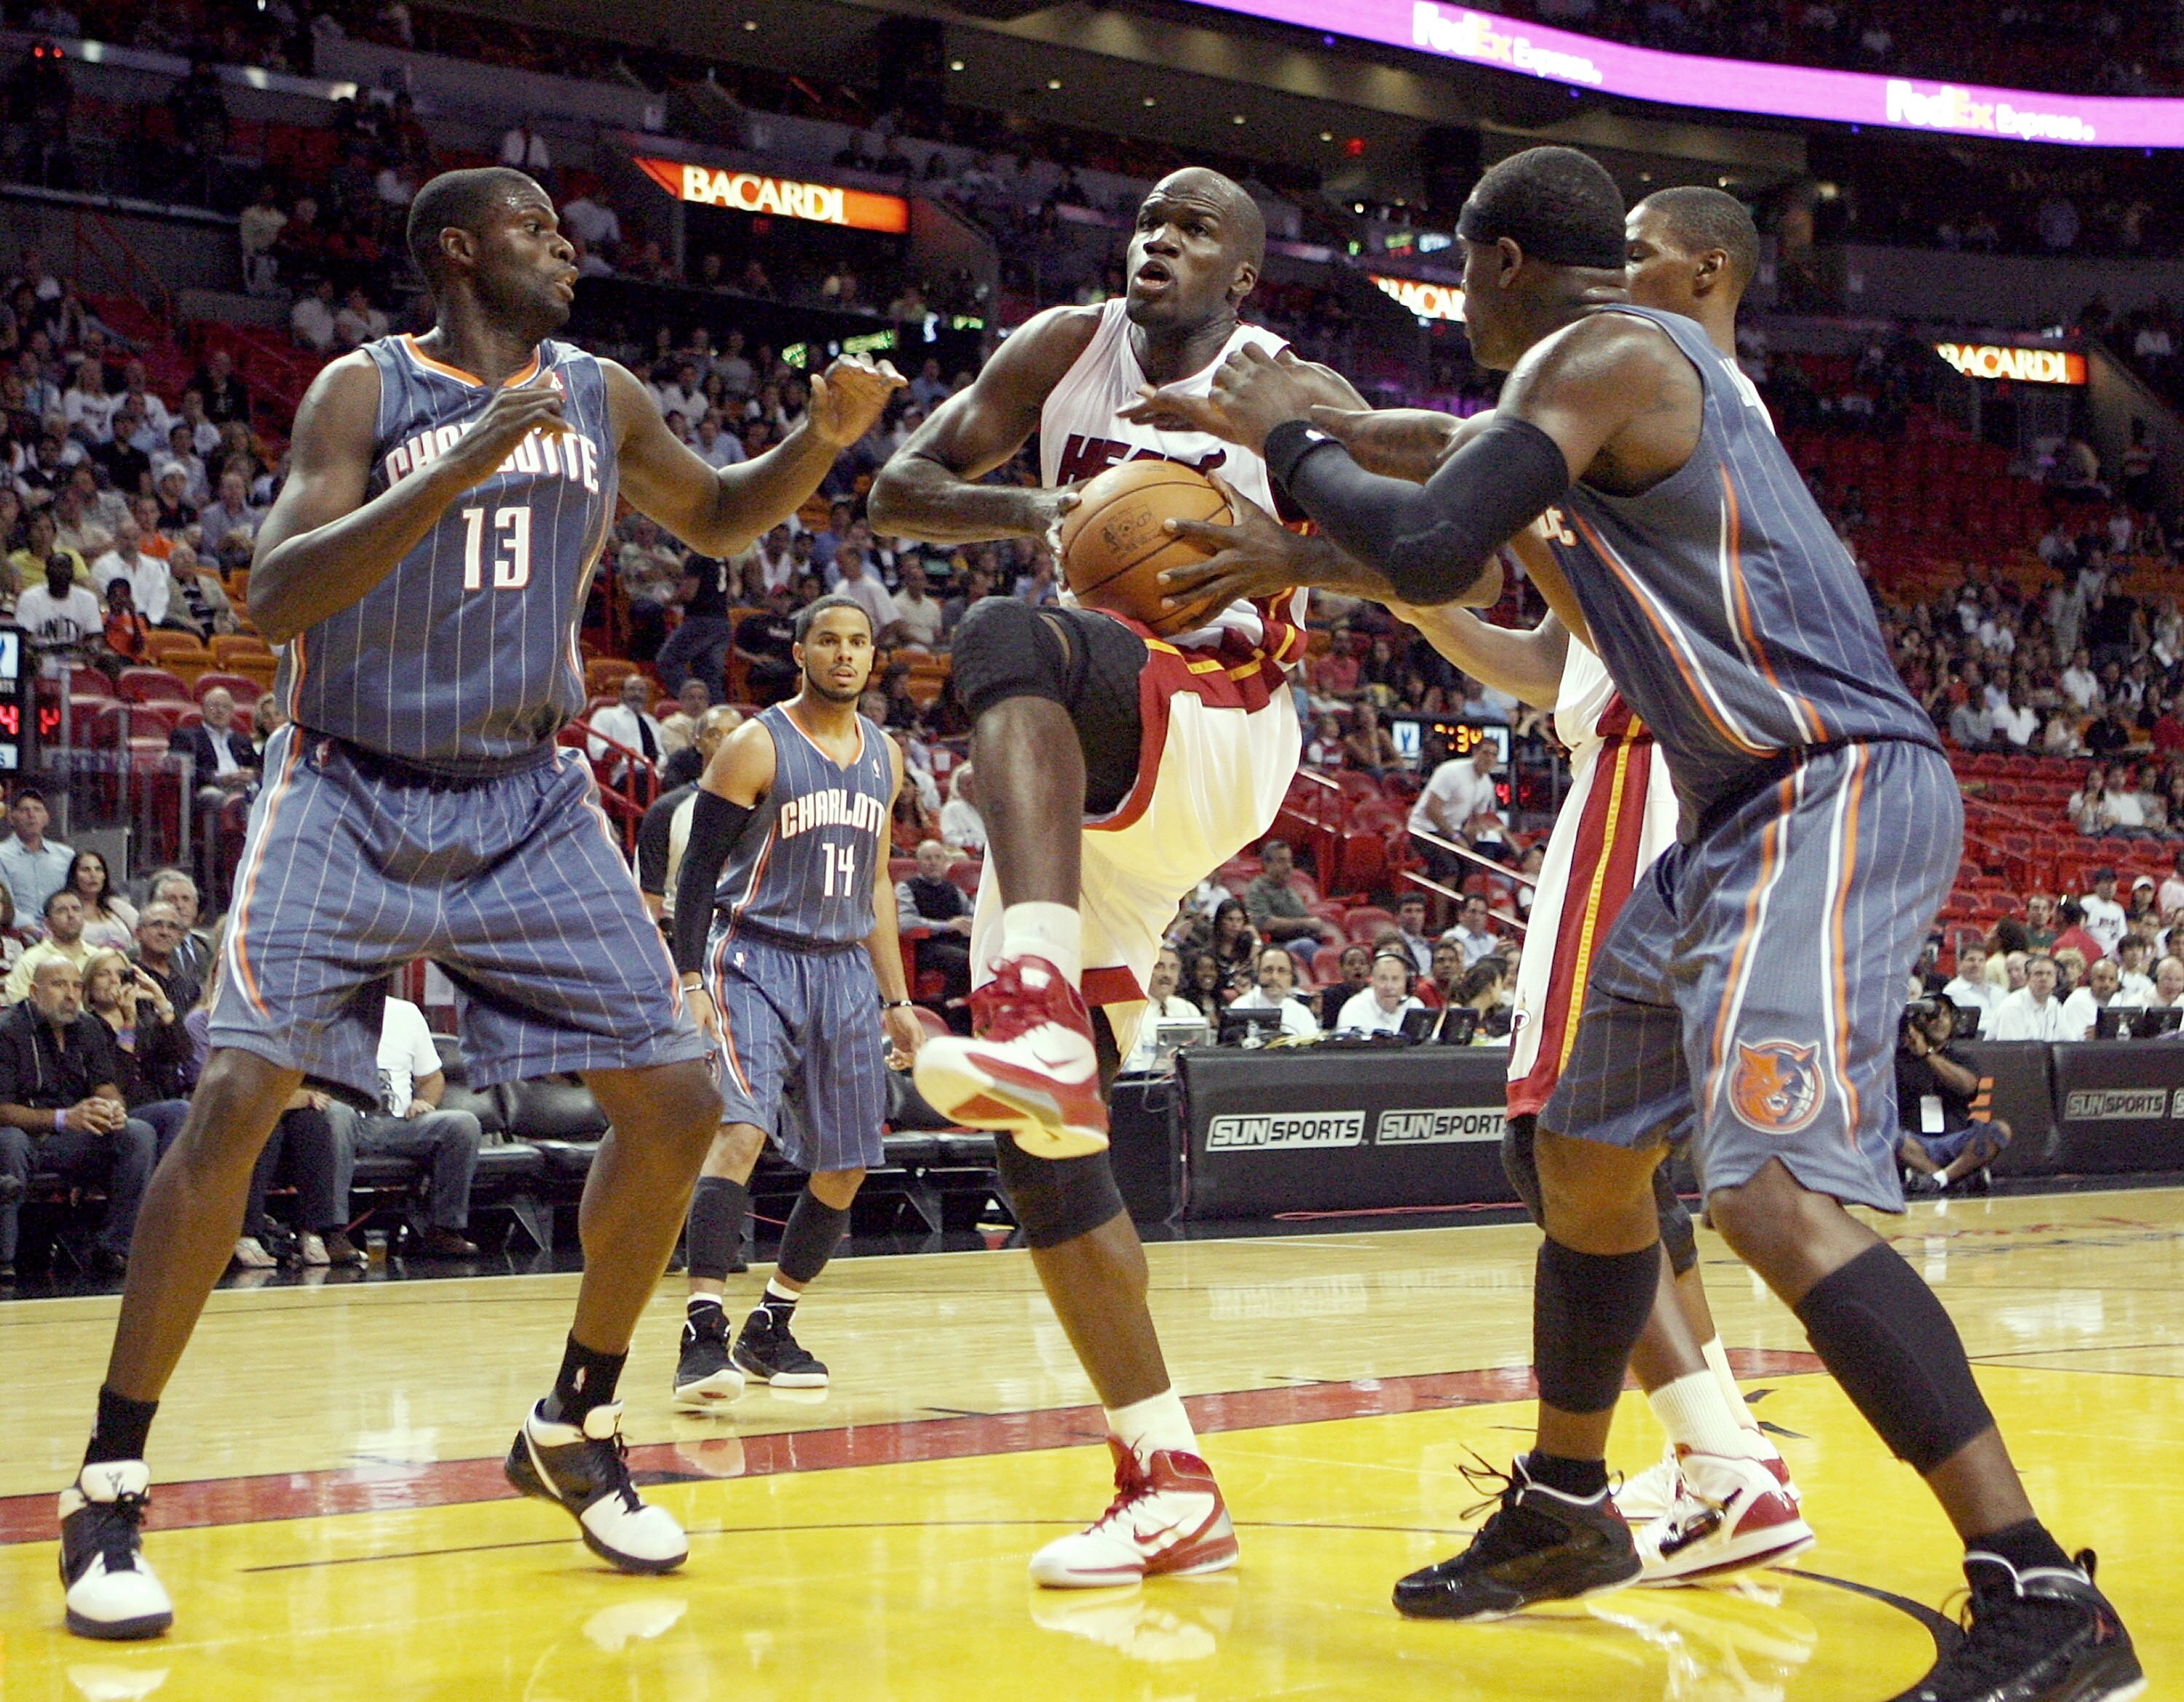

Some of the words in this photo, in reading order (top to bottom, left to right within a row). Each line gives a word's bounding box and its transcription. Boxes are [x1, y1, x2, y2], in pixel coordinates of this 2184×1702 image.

[1413, 1, 1513, 63] FedEx
[1886, 79, 1995, 130] FedEx
[682, 165, 844, 224] BACARDI
[461, 506, 534, 590] 13
[822, 842, 855, 897] 14
